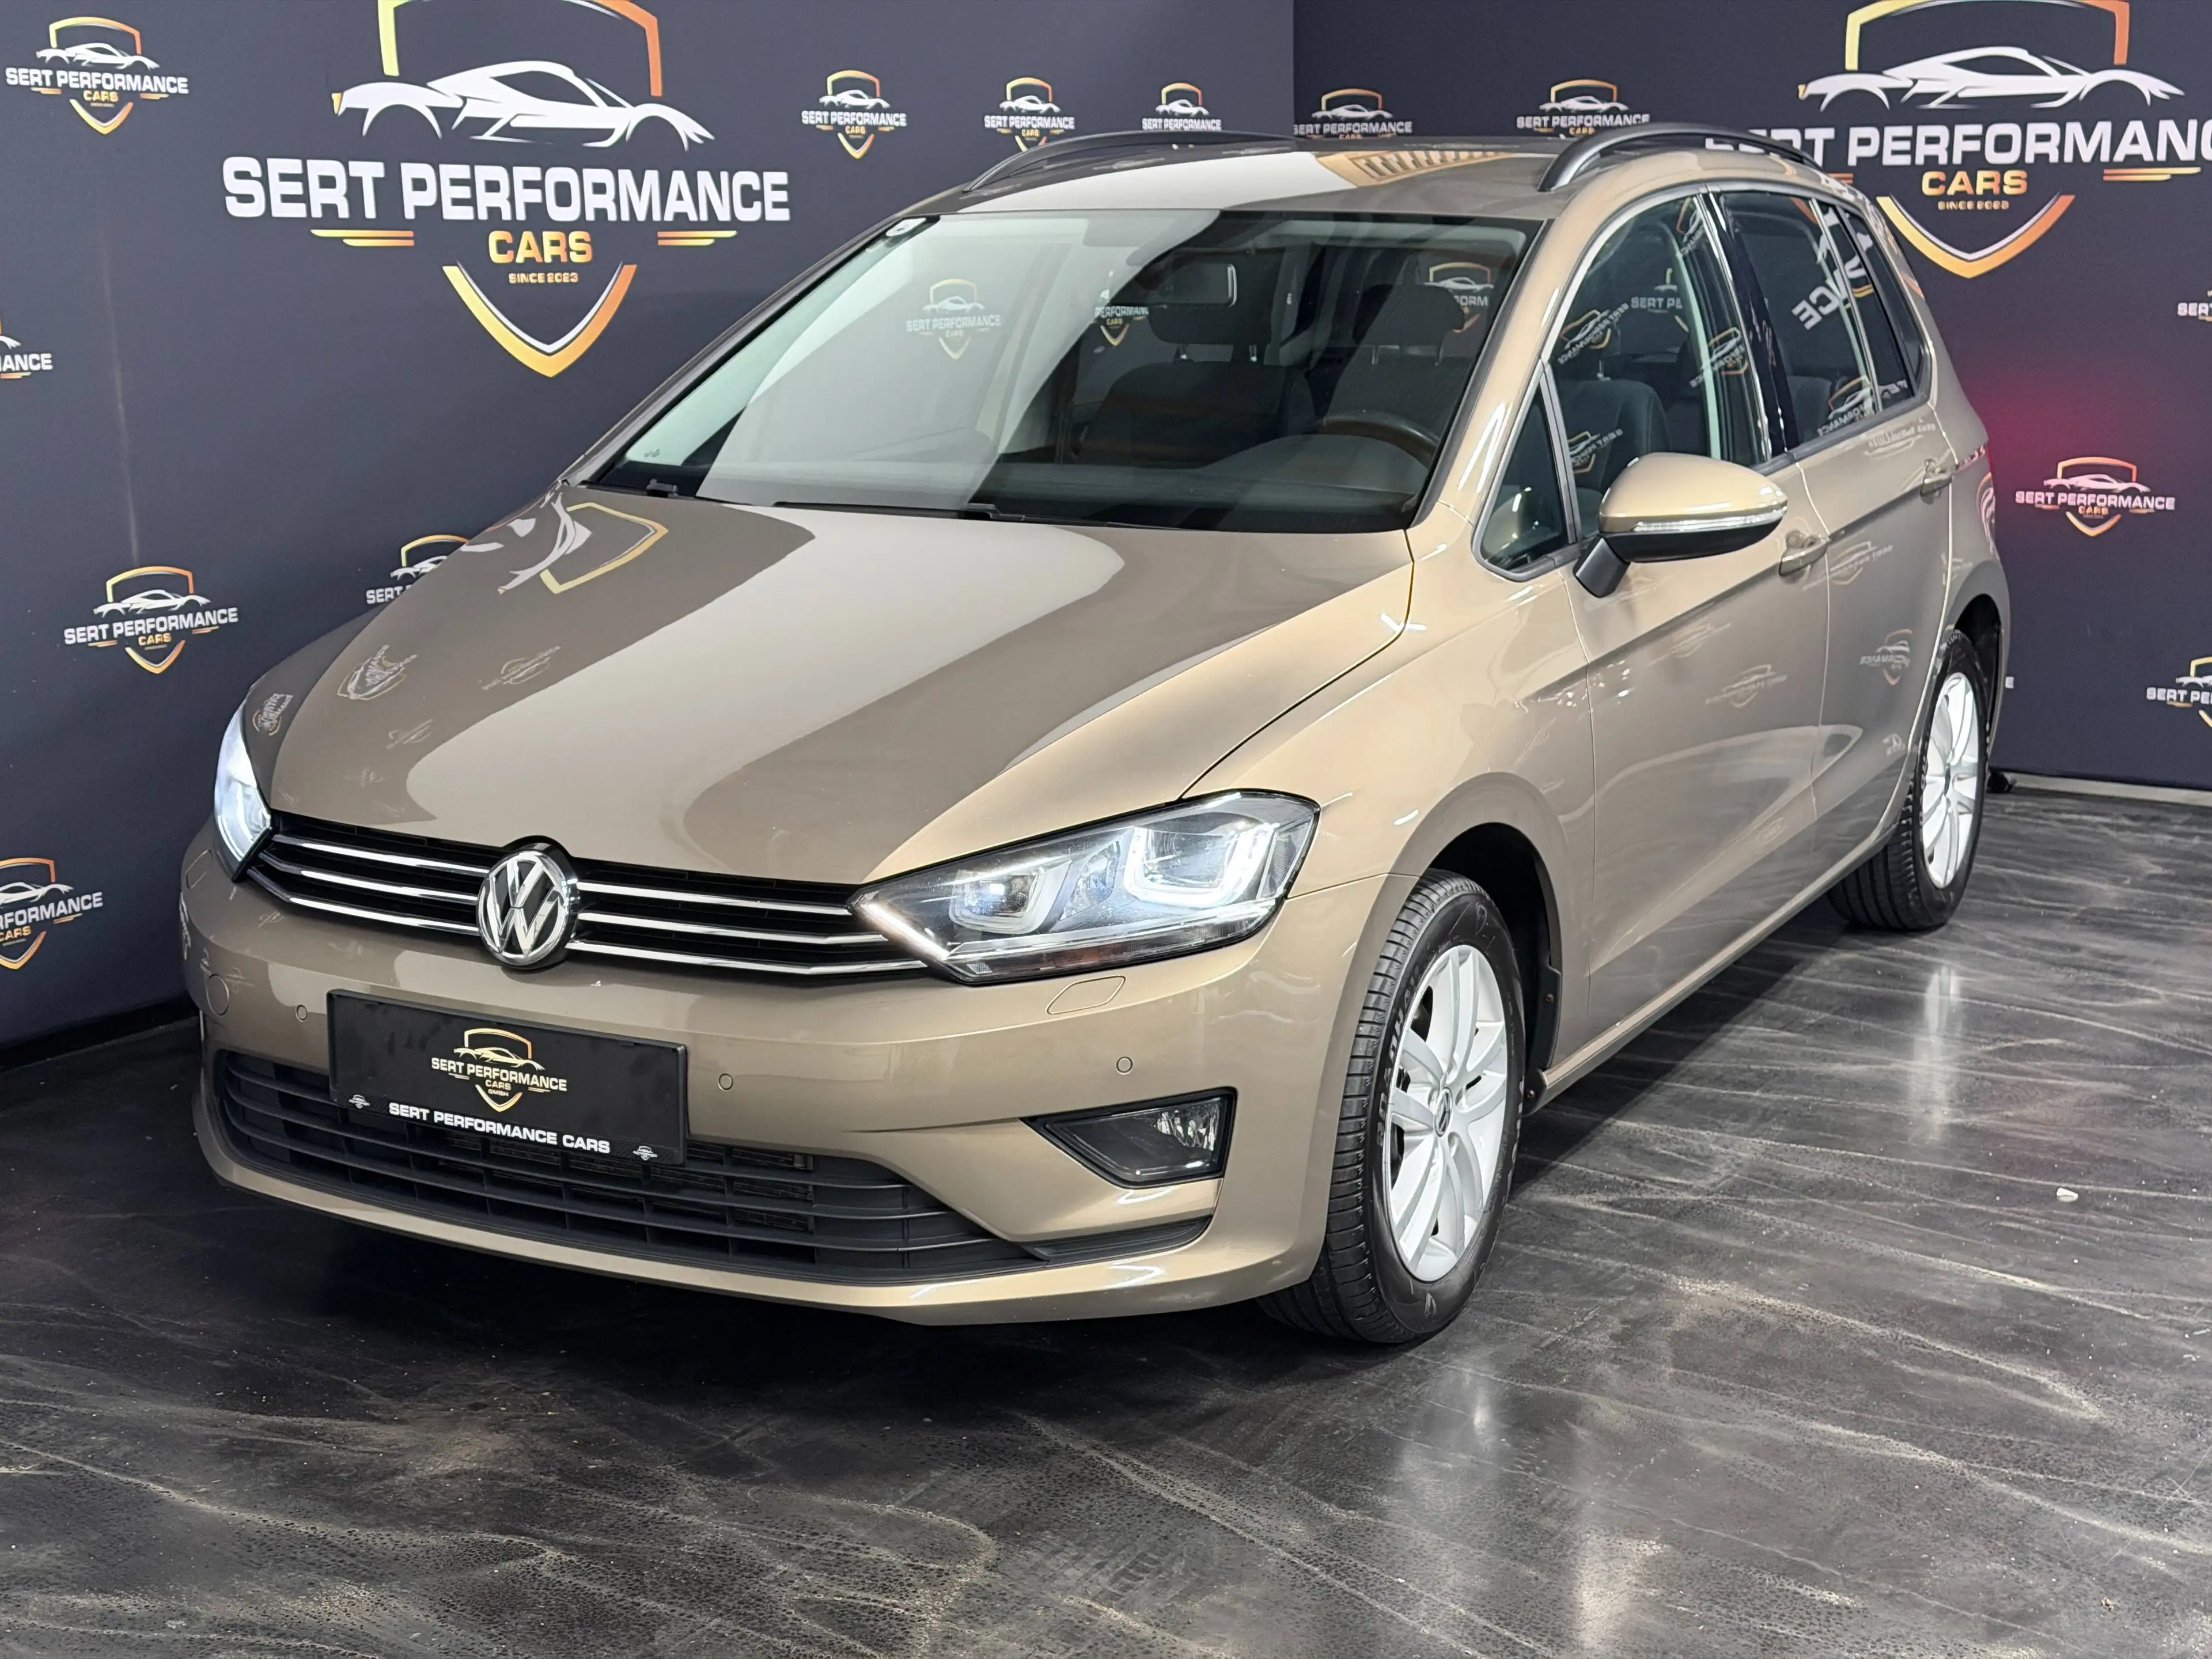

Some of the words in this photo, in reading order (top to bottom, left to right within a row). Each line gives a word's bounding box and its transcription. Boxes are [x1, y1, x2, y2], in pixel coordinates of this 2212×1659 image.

[5, 67, 53, 86] SERT
[56, 70, 189, 94] PERFORMANCE
[83, 90, 119, 102] CARS
[801, 111, 829, 124] SERT
[831, 111, 908, 126] PERFORMANCE
[984, 115, 1008, 128] SERT
[1009, 116, 1075, 130] PERFORMANCE
[1142, 118, 1163, 130] SERT
[1164, 118, 1222, 131] PERFORMANCE
[1516, 116, 1550, 128] SERT
[1551, 113, 1650, 128] PERFORMANCE
[1323, 121, 1413, 135] PERFORMANCE
[222, 157, 385, 219] SERT
[400, 162, 791, 222] PERFORMANCE
[1922, 169, 2028, 196] CARS
[488, 230, 593, 263] CARS
[508, 272, 545, 284] SINCE
[1631, 297, 1664, 309] SERT
[2177, 302, 2212, 316] SER
[0, 353, 53, 372] ANCE
[2016, 491, 2055, 505] SERT
[2057, 492, 2176, 511] PERFORMANCE
[366, 585, 404, 604] SERT
[63, 624, 110, 645] SERT
[112, 607, 239, 638] PERFORMANCE
[138, 632, 172, 646] CARS
[2146, 687, 2188, 703] SERT
[2190, 690, 2212, 704] PE
[431, 1057, 464, 1074] SERT
[467, 1063, 567, 1092] PERFORMANCE
[484, 1079, 512, 1091] CARS
[388, 1102, 430, 1121] SERT
[433, 1110, 558, 1145] PERFORMANCE
[562, 1130, 611, 1154] CARS
